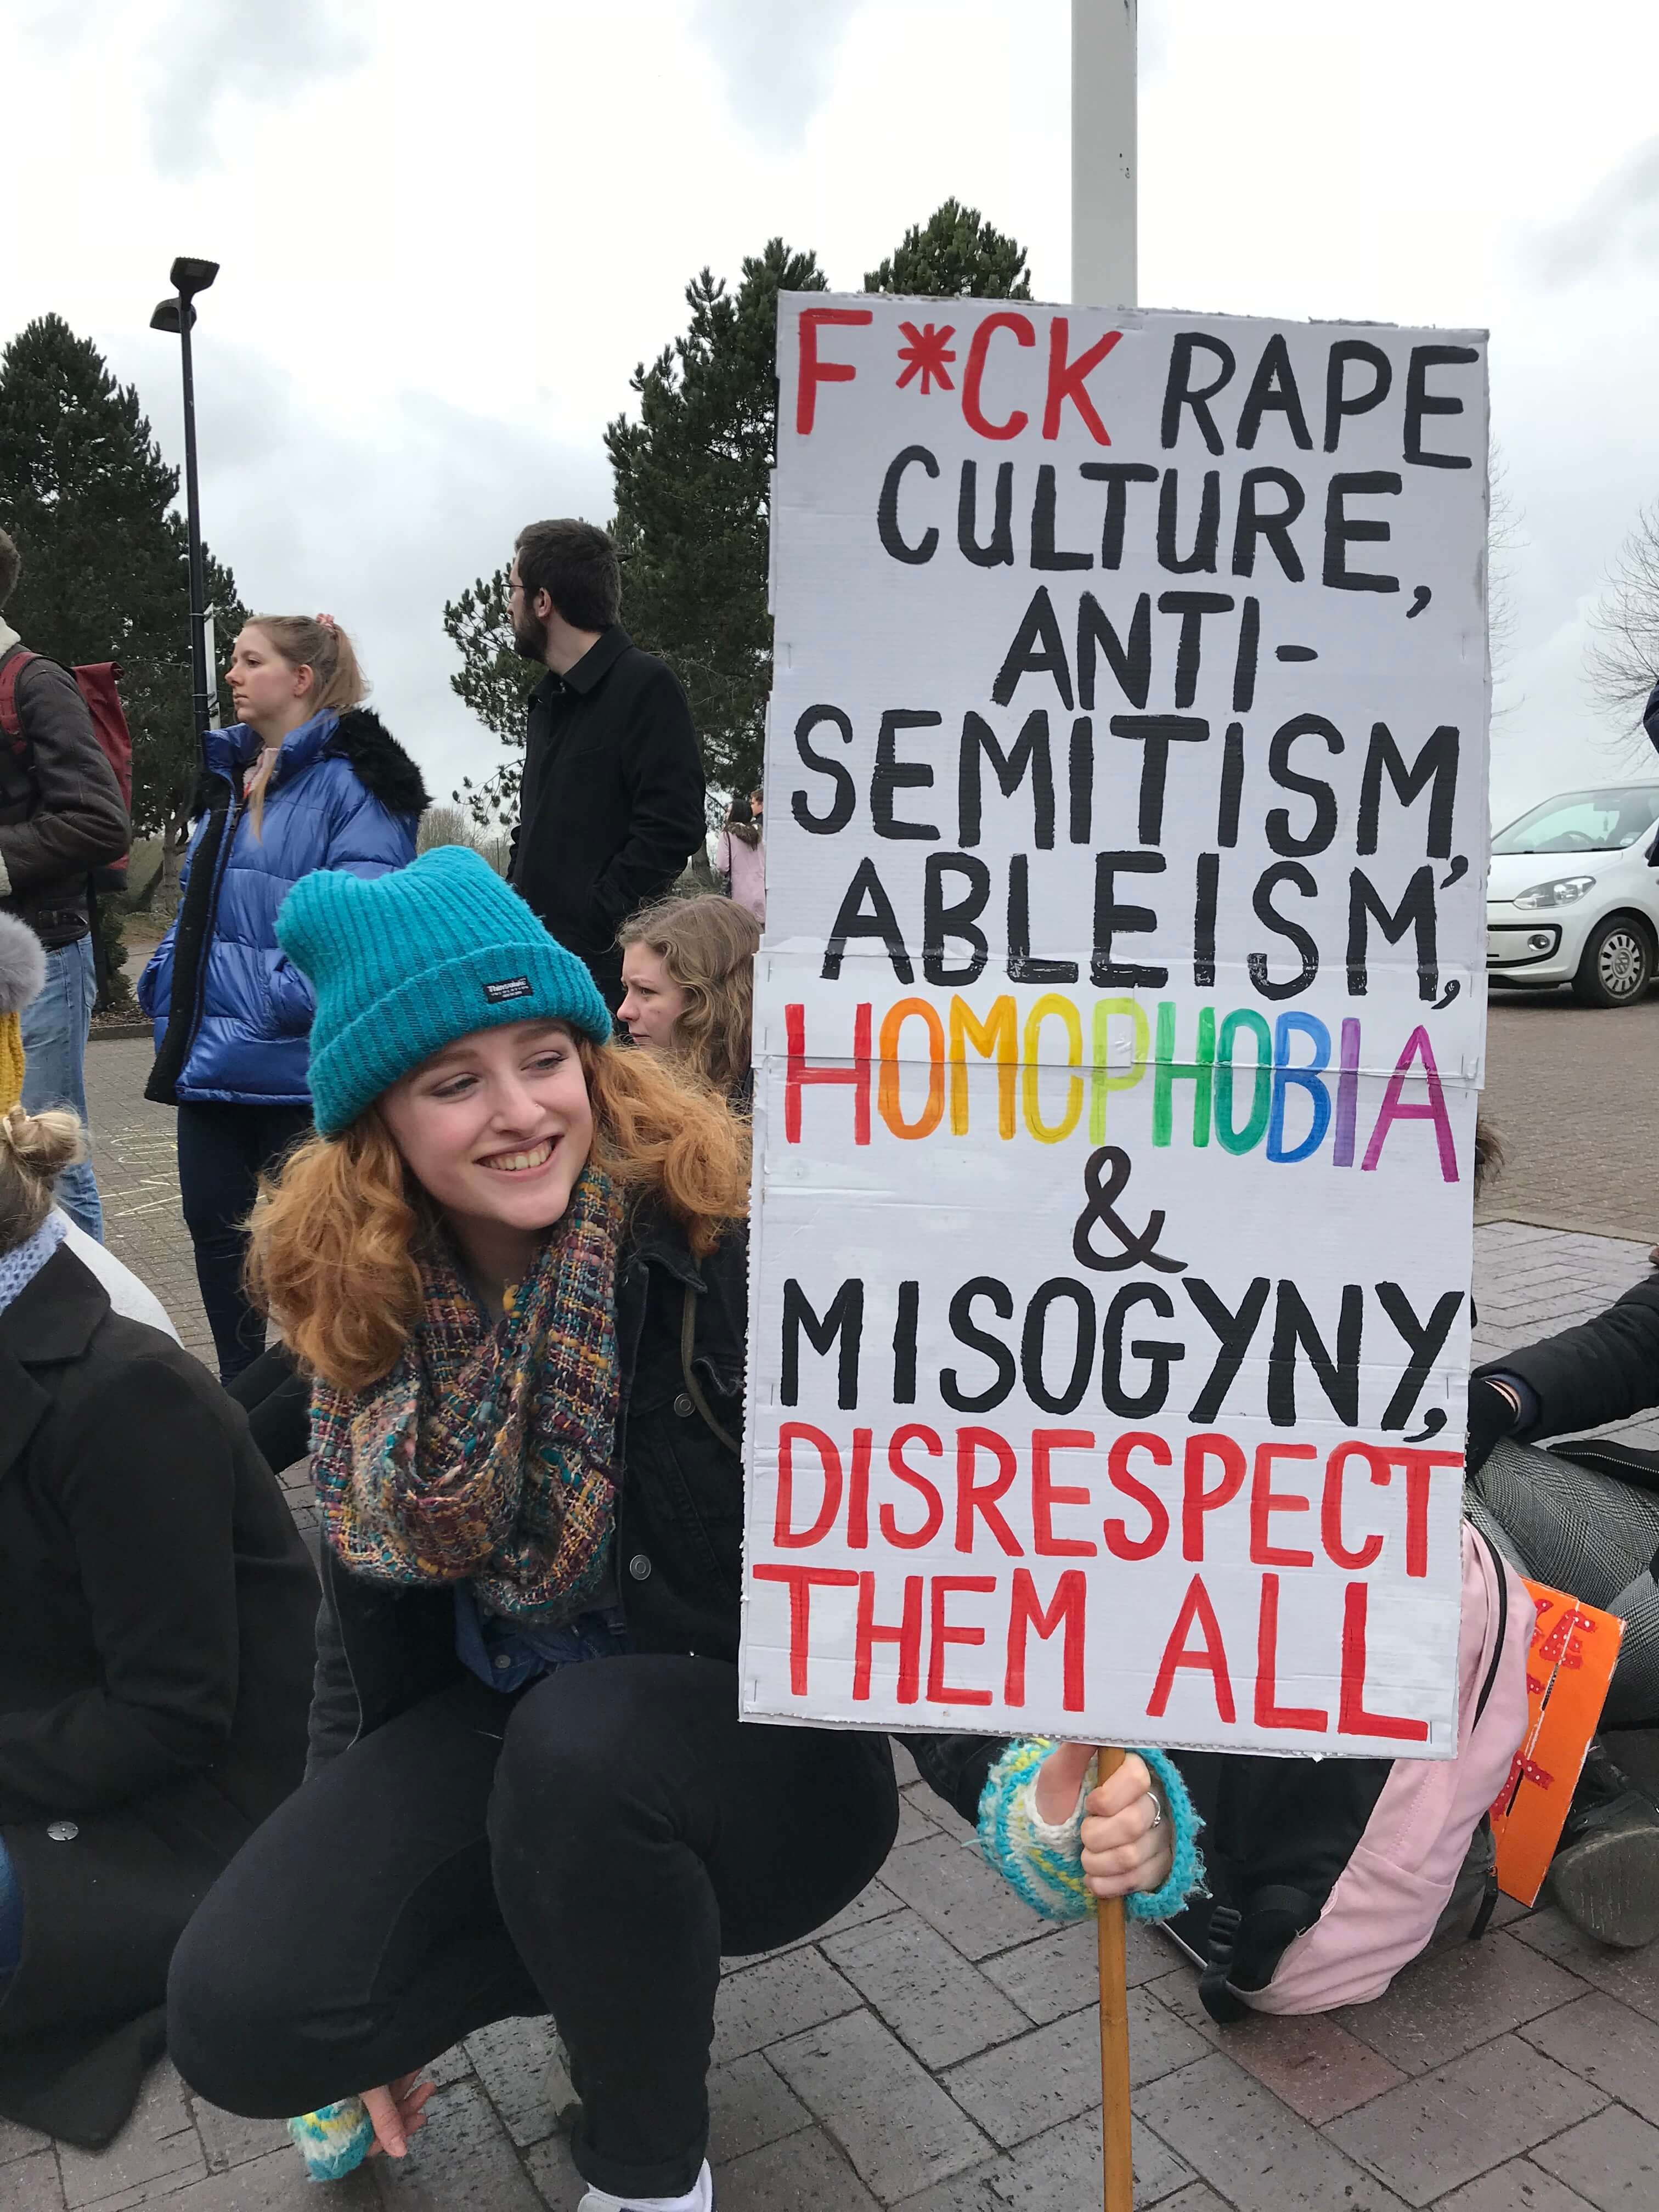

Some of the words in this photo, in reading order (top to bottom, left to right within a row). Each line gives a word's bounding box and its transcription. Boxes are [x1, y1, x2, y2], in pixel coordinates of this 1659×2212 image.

[1161, 332, 1480, 469] RAPE
[877, 445, 1432, 619] CULTURE,
[992, 585, 1318, 713] ANTI-
[792, 704, 1469, 890] SEMITISM,
[819, 851, 1461, 1010] ABLEISM,
[784, 994, 1460, 1183] HOMOPHOBIA
[1073, 1146, 1189, 1274] &
[780, 1277, 1465, 1443] MISOGYNY,
[772, 1422, 1464, 1578] DISRESPECT
[752, 1564, 1087, 1713] THEM
[1146, 1573, 1429, 1742] ALL
